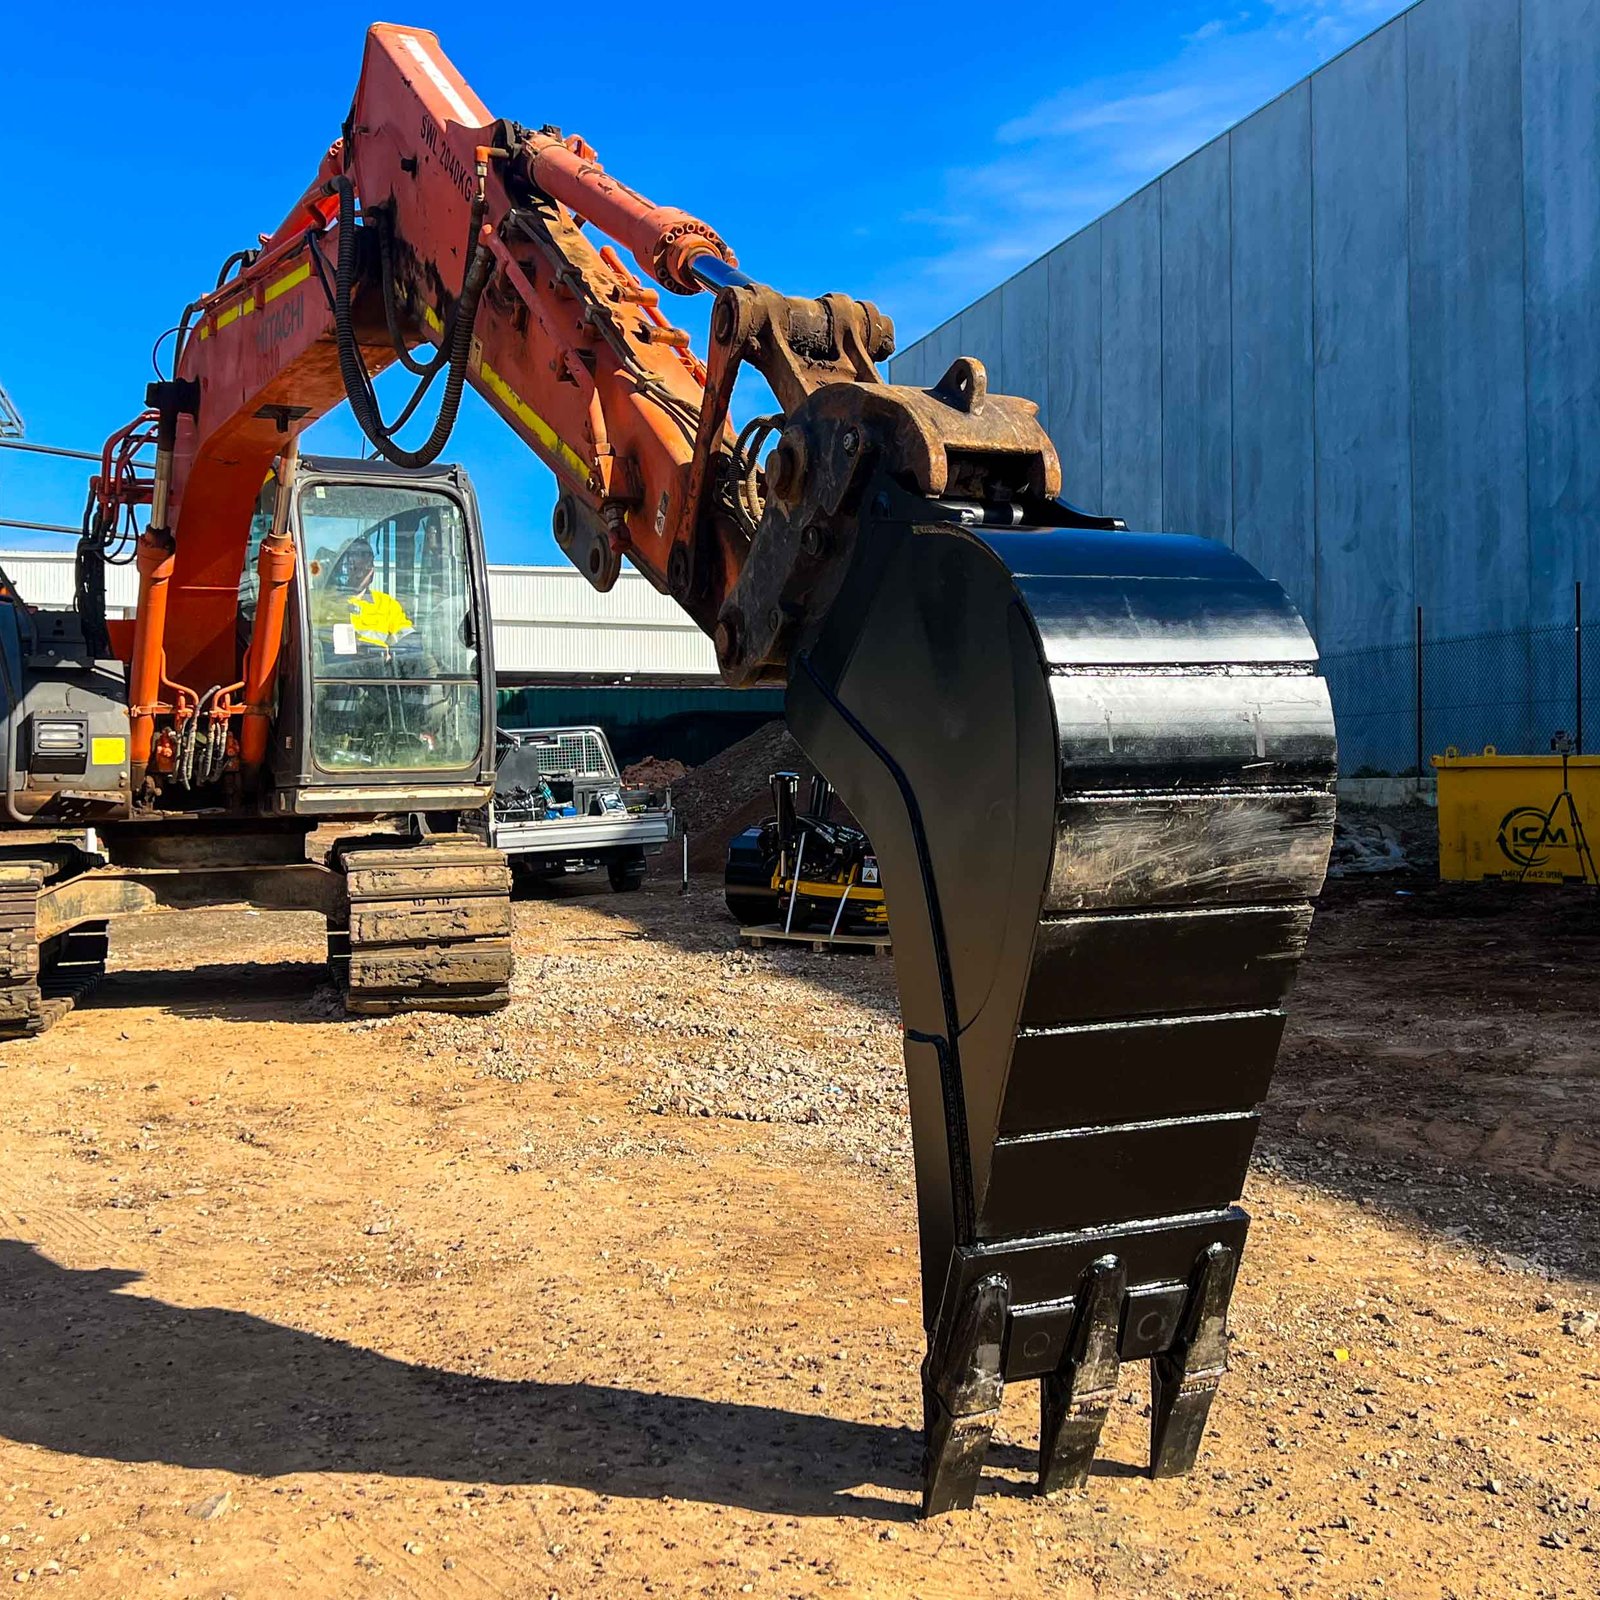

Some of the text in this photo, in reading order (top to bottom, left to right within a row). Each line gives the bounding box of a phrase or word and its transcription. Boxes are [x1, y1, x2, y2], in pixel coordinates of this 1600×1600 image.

[420, 115, 473, 202] SWL 2040KG
[255, 290, 304, 352] HITACHI
[1513, 827, 1568, 843] ICM
